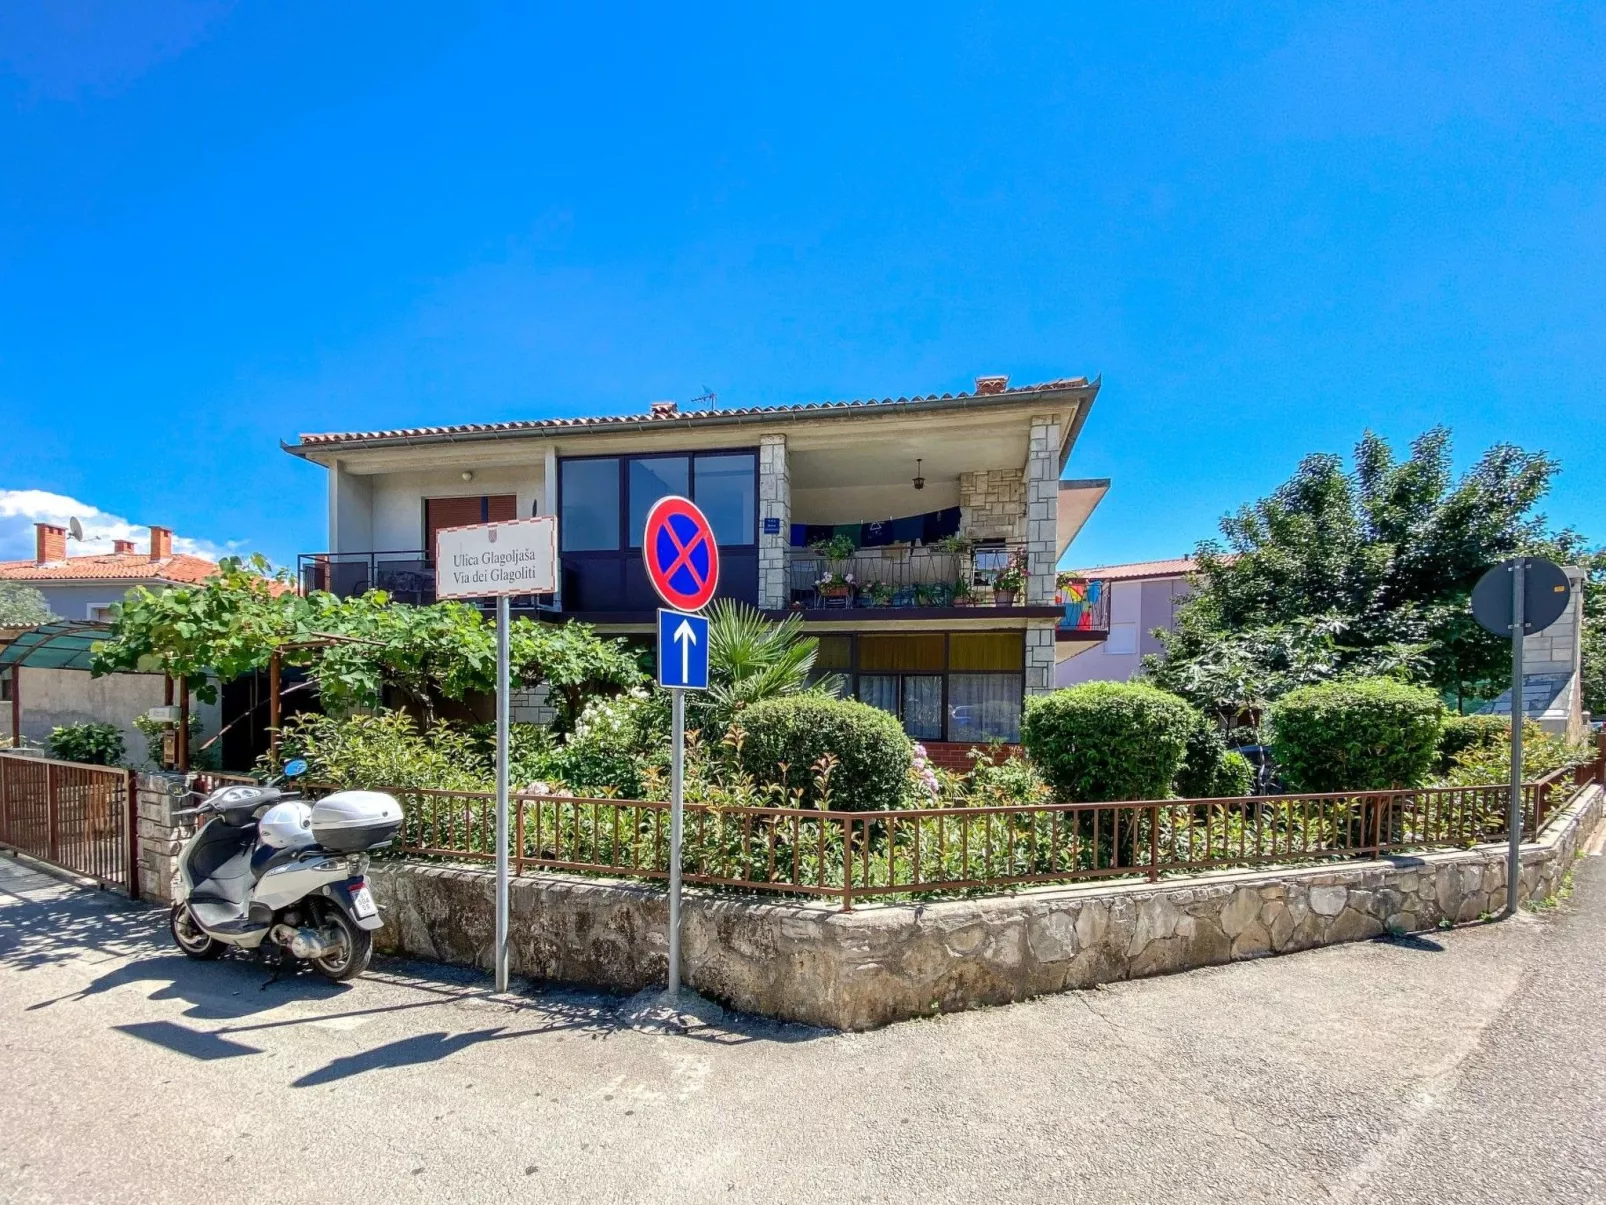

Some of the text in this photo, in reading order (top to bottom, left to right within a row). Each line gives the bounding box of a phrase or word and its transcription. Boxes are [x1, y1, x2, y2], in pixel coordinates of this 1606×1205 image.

[453, 548, 536, 567] Ulica Glagoljaša
[453, 566, 536, 584] Via dei Glagoliti
